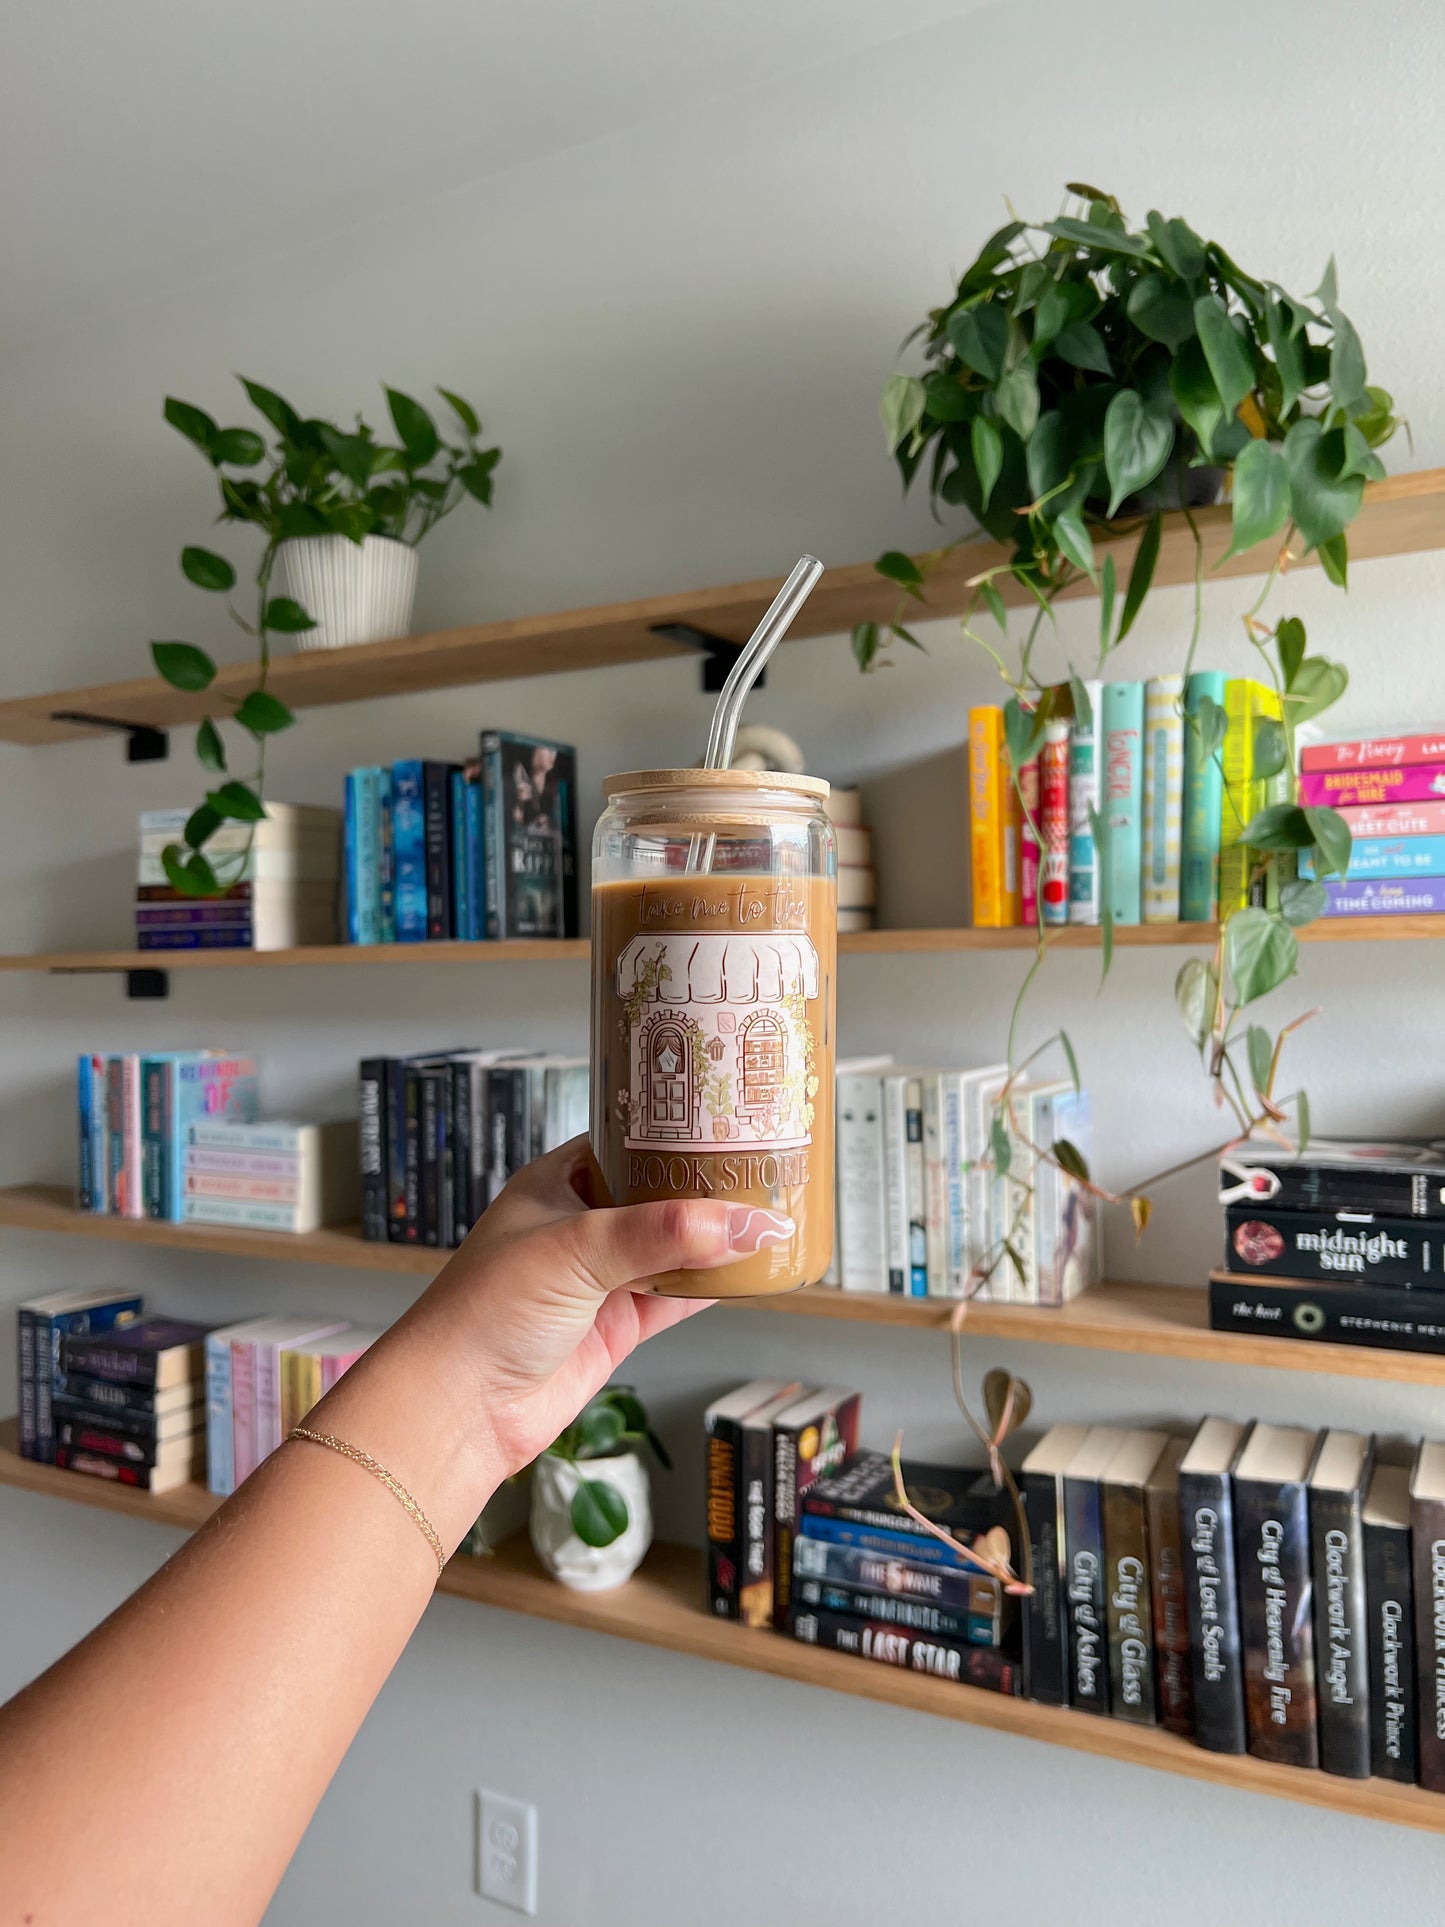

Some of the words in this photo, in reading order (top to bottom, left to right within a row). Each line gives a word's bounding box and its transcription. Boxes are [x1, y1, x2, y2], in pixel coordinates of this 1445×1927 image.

[1324, 769, 1404, 791] BRIDESMAID
[631, 884, 685, 925] take
[691, 897, 730, 920] me
[727, 883, 768, 925] to
[764, 882, 807, 925] the
[1335, 896, 1370, 912] TIME
[628, 1154, 714, 1192] BOOK
[720, 1150, 811, 1192] STORE
[1296, 1228, 1408, 1264] midnight
[1319, 1250, 1366, 1273] sun
[1339, 1315, 1413, 1334] STEPHENIE
[1417, 1324, 1445, 1337] MEY
[708, 1437, 733, 1488] ANNA
[708, 1486, 735, 1543] TODD
[1191, 1507, 1218, 1553] City
[1256, 1519, 1285, 1564] City
[1069, 1550, 1098, 1602] City
[1112, 1556, 1144, 1610] City
[1196, 1554, 1220, 1576] of
[1261, 1565, 1286, 1587] of
[1325, 1529, 1352, 1641] Clockwork
[1074, 1603, 1099, 1629] of
[1199, 1575, 1222, 1620] Lost
[1119, 1612, 1145, 1639] of
[1263, 1586, 1291, 1682] Heavenly
[861, 1627, 910, 1671] LAST
[912, 1640, 962, 1681] STAR
[1076, 1625, 1101, 1697] Ashes
[1120, 1637, 1147, 1705] Glass
[1201, 1622, 1227, 1682] Souls
[1381, 1599, 1405, 1700] Clockwork
[1324, 1641, 1354, 1706] Angel
[1270, 1684, 1292, 1725] Fire
[1385, 1701, 1406, 1760] Prince
